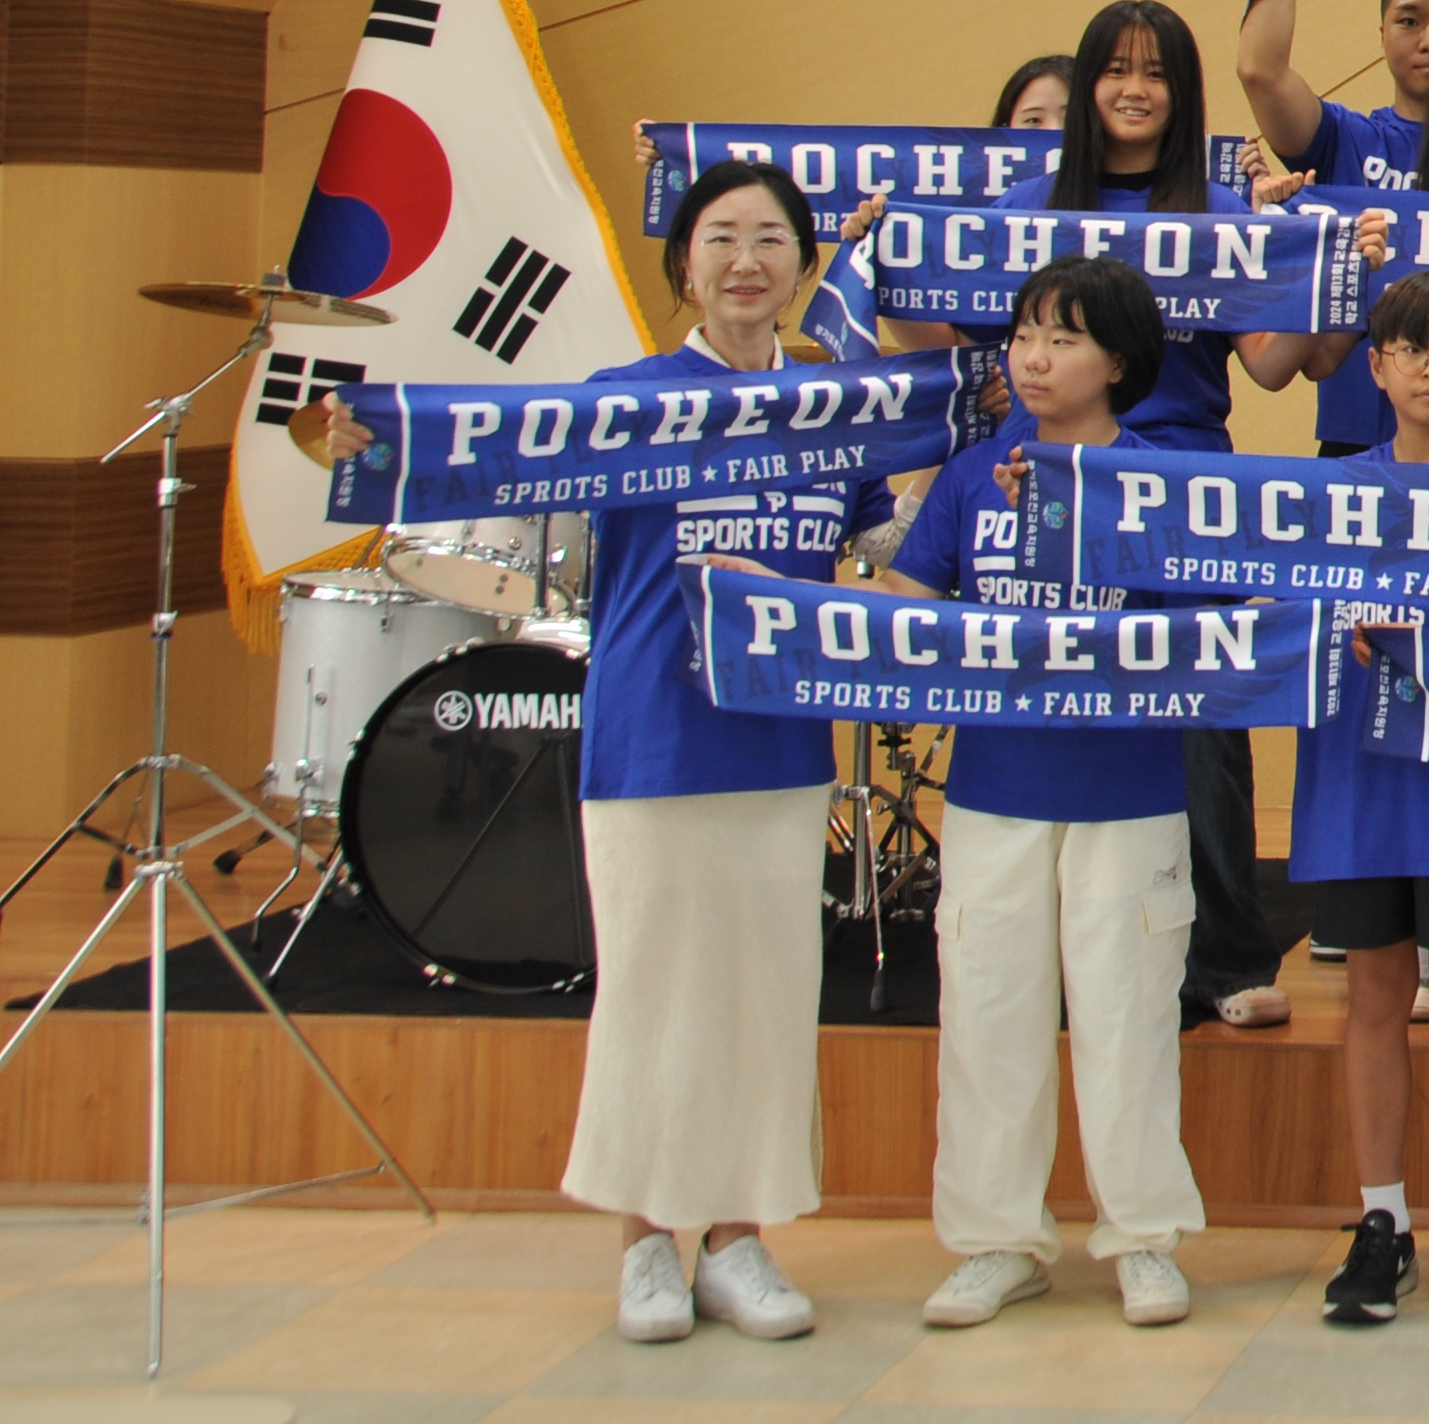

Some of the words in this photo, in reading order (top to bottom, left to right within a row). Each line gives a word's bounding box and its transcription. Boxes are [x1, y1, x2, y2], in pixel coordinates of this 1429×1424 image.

[1330, 262, 1345, 298] 제13회
[878, 287, 959, 314] PORTS
[1329, 299, 1342, 326] 2024
[1344, 300, 1359, 325] 학교
[448, 372, 914, 466] POCHEON
[494, 475, 609, 507] SPROTS
[622, 465, 692, 496] CLUB
[727, 454, 789, 484] FAIR
[798, 445, 866, 474] PLAY
[675, 519, 790, 553] SPORTS
[1163, 556, 1276, 587] SPORTS
[1290, 563, 1364, 591] CLUB
[977, 575, 1062, 609] SPORTS
[1070, 582, 1126, 611] CLUB
[745, 595, 1260, 673] POCHEON
[1328, 648, 1342, 686] 제13회
[473, 691, 582, 730] YAMAH
[794, 680, 911, 709] SPORTS
[926, 687, 1003, 713] CLUB
[1042, 691, 1112, 716] FAIR
[1127, 691, 1206, 718] PLAY
[1326, 688, 1338, 717] 2024
